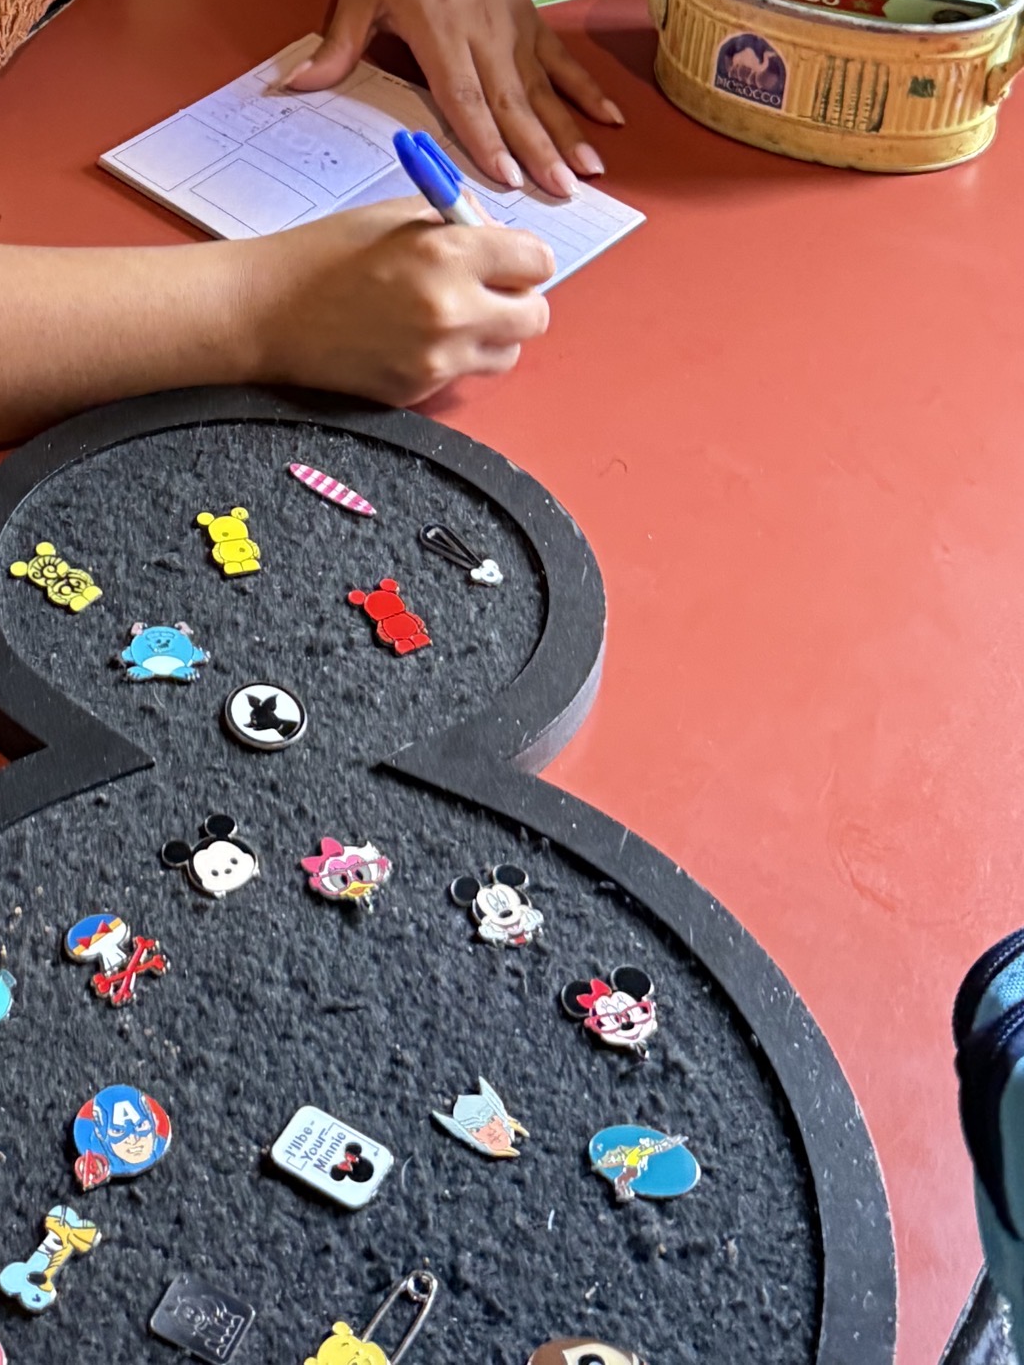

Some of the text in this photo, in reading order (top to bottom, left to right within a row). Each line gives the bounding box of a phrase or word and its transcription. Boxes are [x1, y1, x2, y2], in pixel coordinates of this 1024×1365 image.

[717, 75, 781, 105] MOROCCO
[112, 1100, 141, 1127] A
[313, 1132, 346, 1174] Minnie
